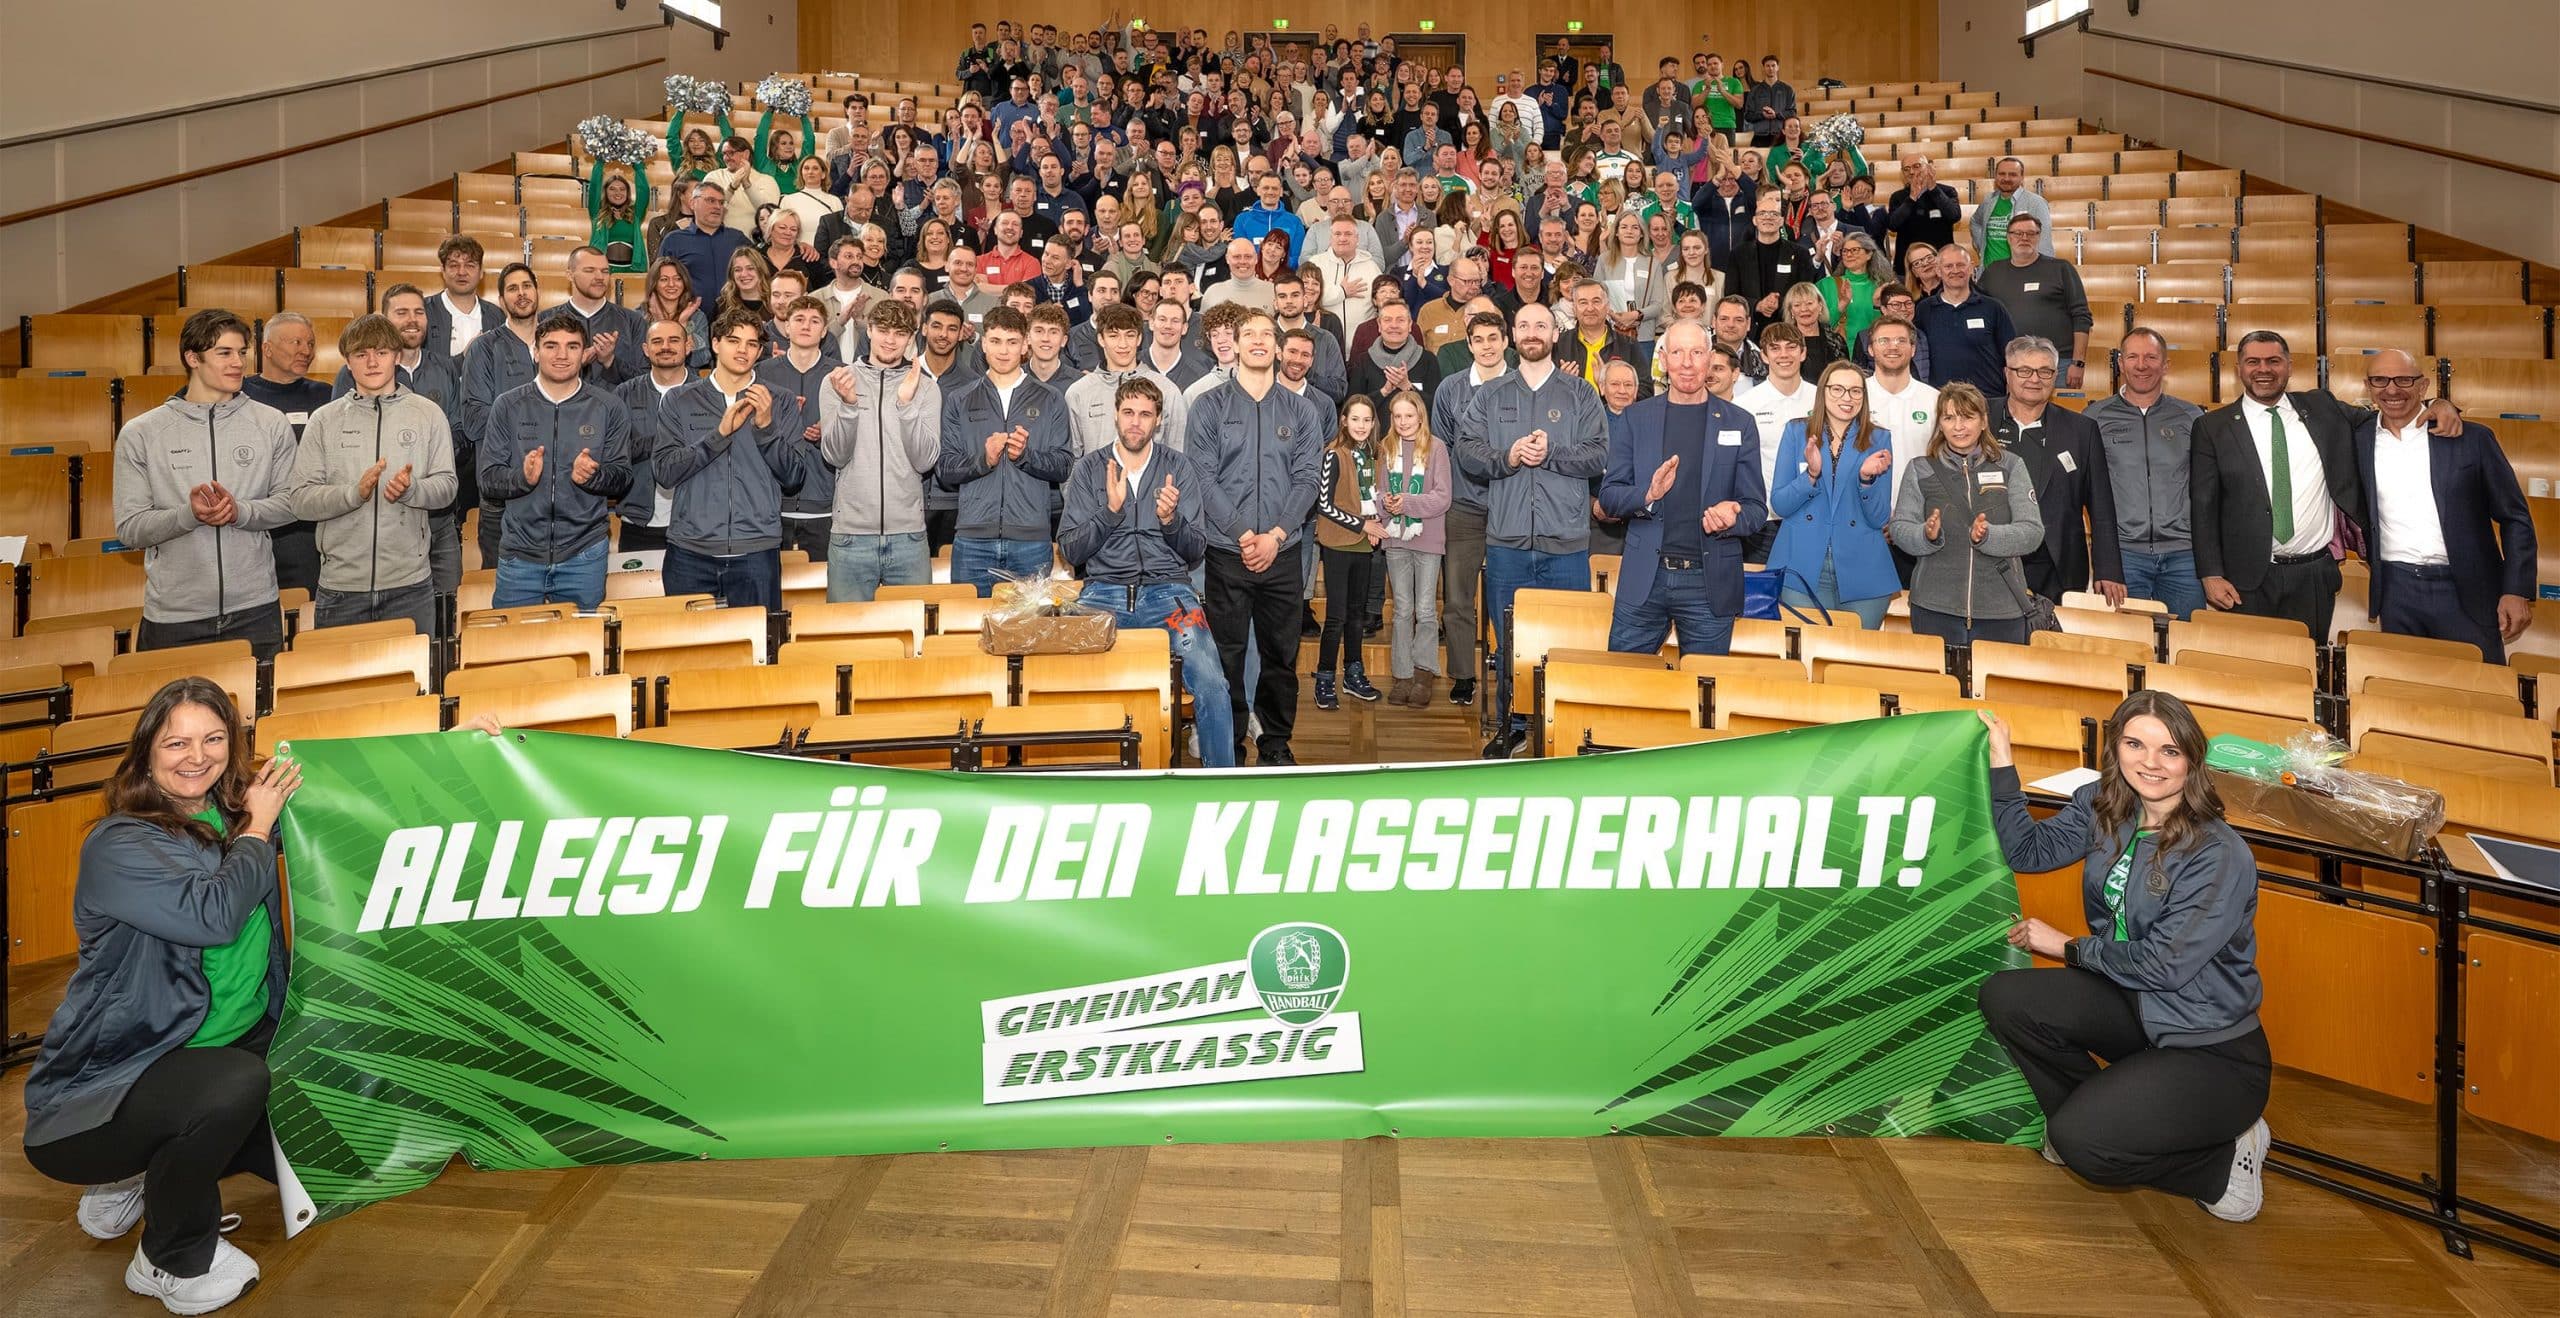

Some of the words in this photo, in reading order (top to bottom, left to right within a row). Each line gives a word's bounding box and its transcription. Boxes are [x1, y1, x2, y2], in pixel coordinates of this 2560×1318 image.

[357, 814, 730, 932] ALLE(S)
[744, 786, 942, 909] FÜR
[965, 802, 1153, 905] DEN
[1175, 794, 1937, 897] KLASSENERHALT!
[996, 970, 1247, 1038] GEMEINSAM
[1267, 993, 1329, 1012] HANDBALL
[996, 1026, 1338, 1088] ERSTKLASSIG
